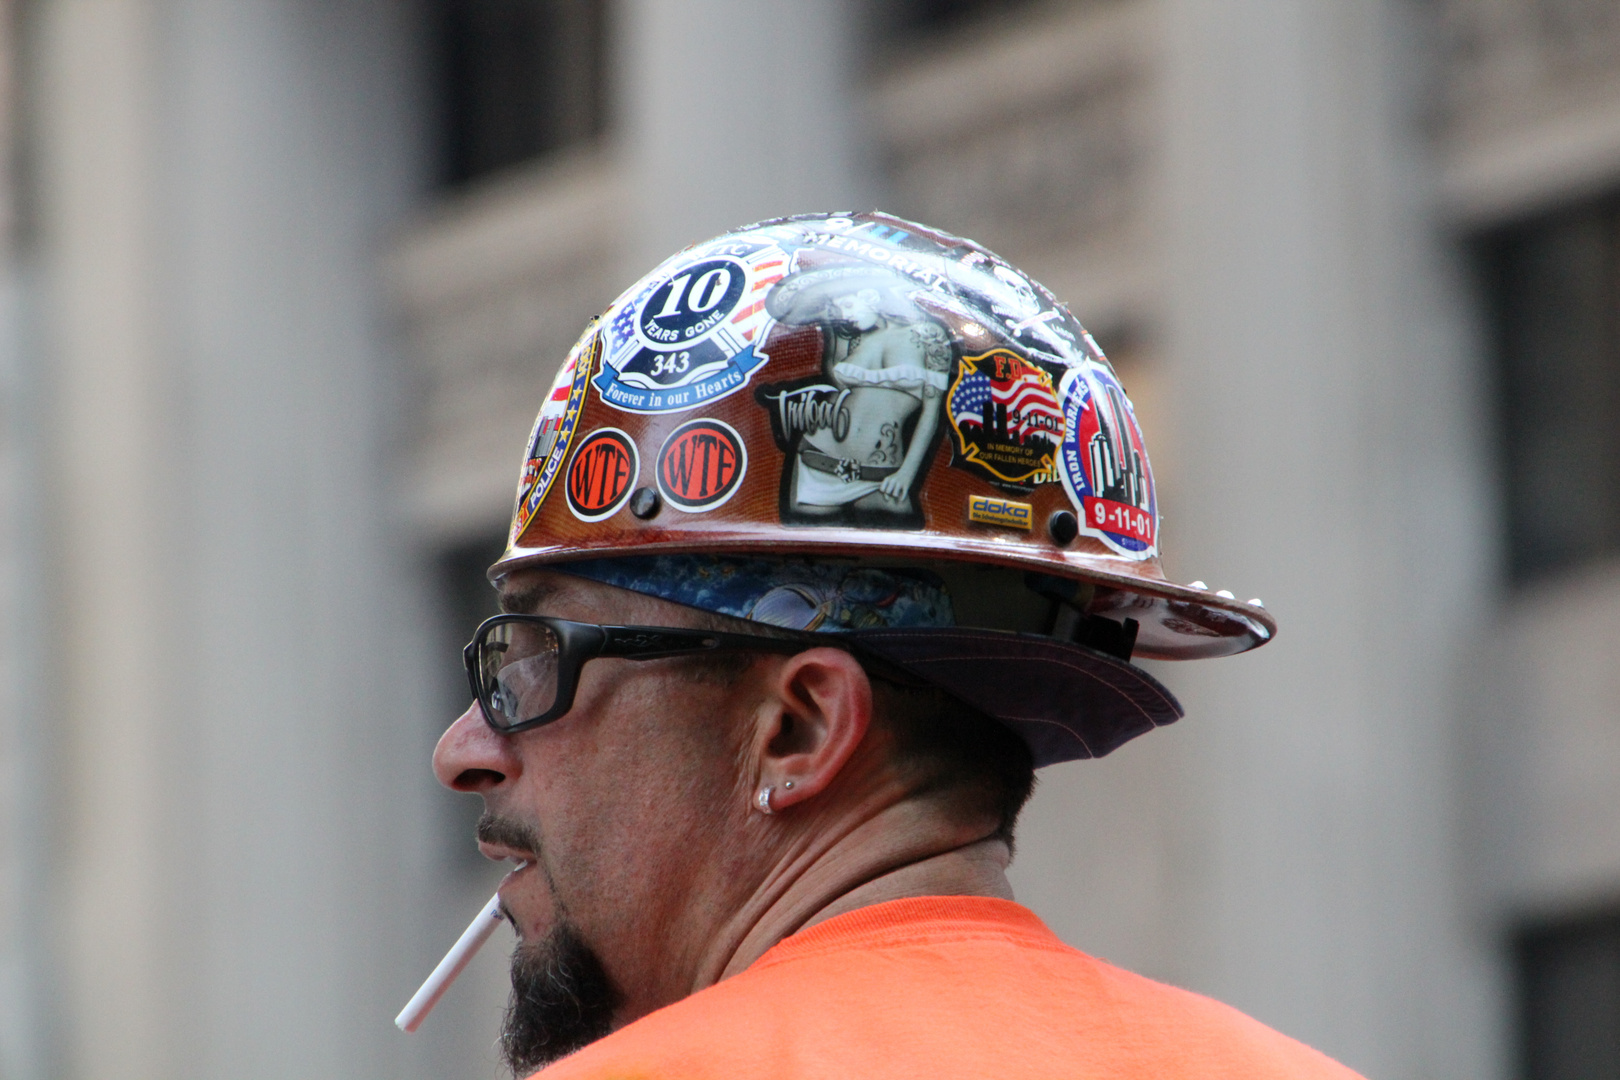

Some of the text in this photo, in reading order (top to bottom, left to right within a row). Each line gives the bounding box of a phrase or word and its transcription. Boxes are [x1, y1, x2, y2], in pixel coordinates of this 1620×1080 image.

[824, 217, 909, 244] 9/11
[652, 268, 731, 319] 10
[643, 309, 725, 341] YEARS GONE
[650, 351, 690, 376] 343
[605, 369, 742, 407] Forever in our Hearts
[1012, 409, 1060, 432] 9-11-01
[668, 433, 735, 497] WTF
[980, 452, 994, 461] OUR
[994, 453, 1017, 463] FALLEN
[996, 444, 1024, 454] MEMORY
[529, 446, 564, 509] POLICE
[575, 443, 630, 506] WTF
[1067, 449, 1086, 492] IRON
[973, 499, 1029, 518] doka
[1094, 503, 1152, 539] 9-11-01
